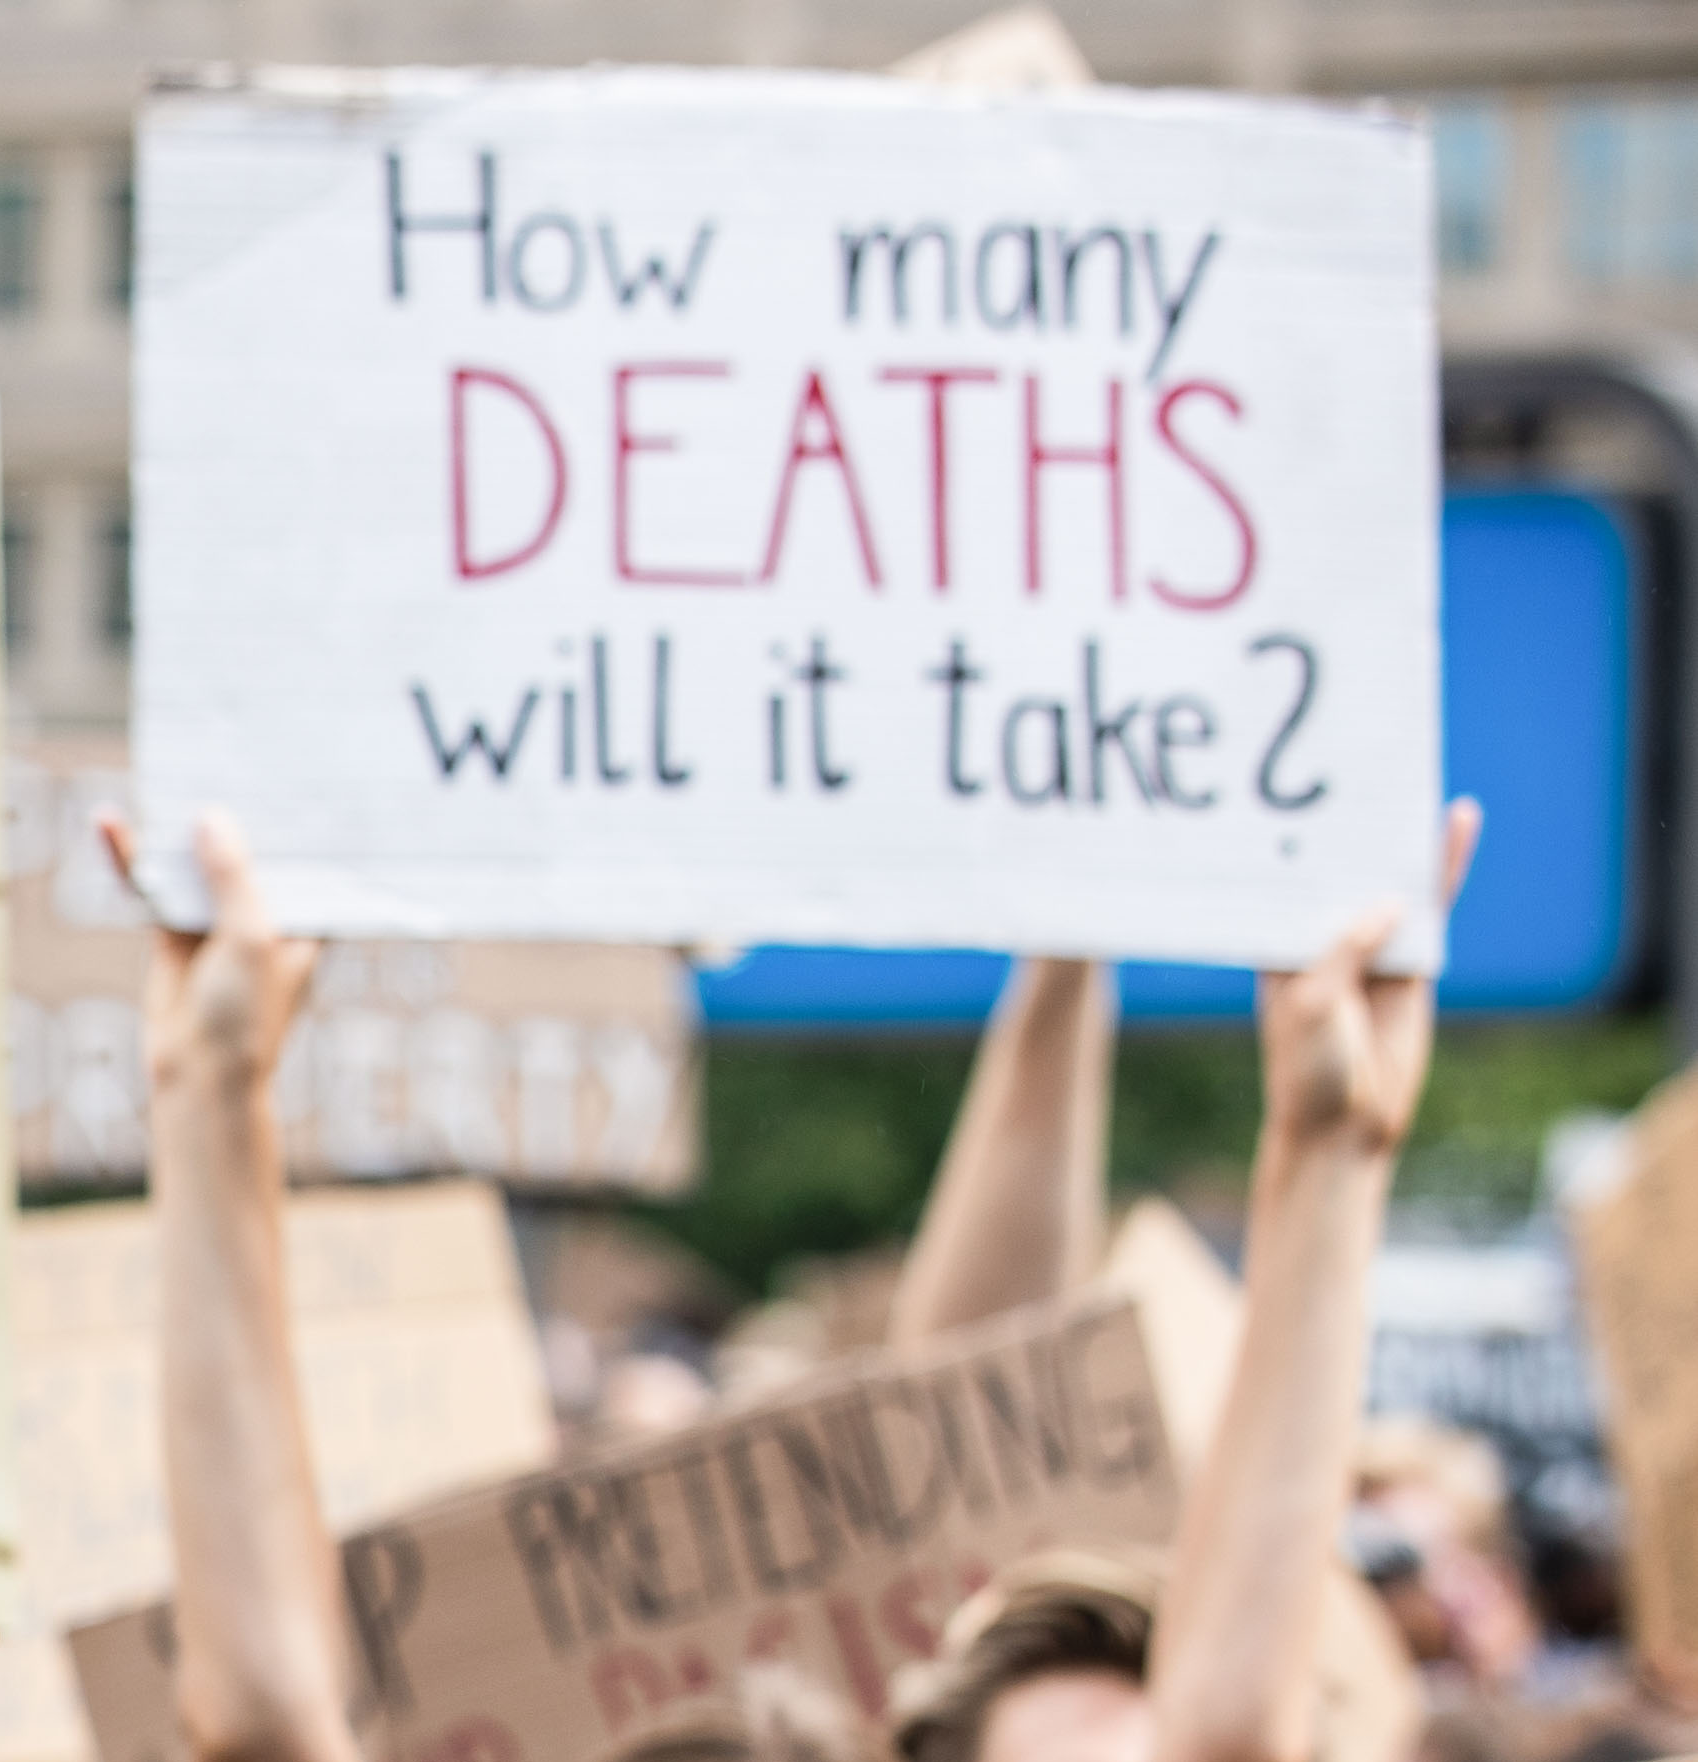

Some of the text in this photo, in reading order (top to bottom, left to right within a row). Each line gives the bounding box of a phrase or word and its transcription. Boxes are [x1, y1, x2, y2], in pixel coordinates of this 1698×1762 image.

[381, 147, 1222, 383] How many
[447, 360, 1260, 614] DEATHS
[409, 632, 1330, 858] will it take?
[500, 1305, 1165, 1662] PRETENDING
